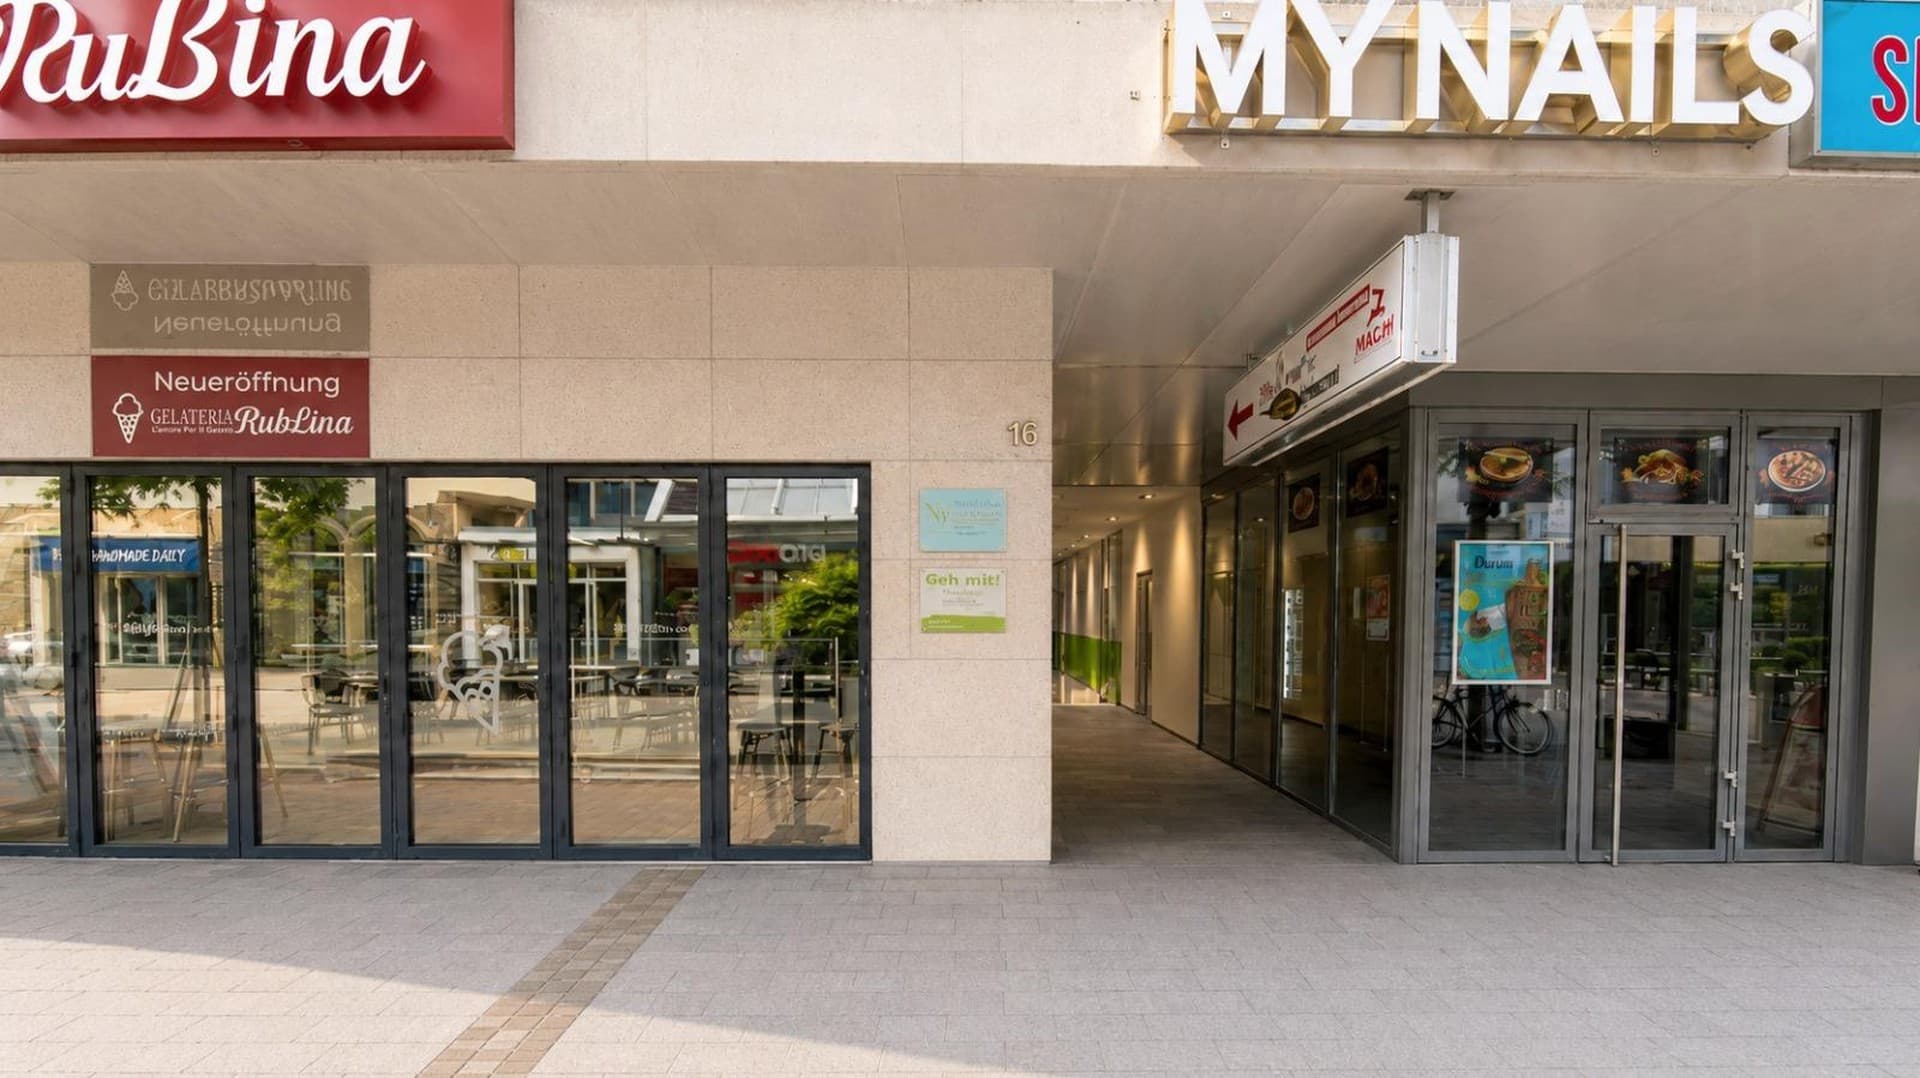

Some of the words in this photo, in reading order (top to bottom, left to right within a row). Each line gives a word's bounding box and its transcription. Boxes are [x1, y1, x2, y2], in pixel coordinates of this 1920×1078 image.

[1870, 34, 1920, 126] S
[154, 371, 340, 398] Neueröffnung
[150, 408, 233, 425] GELATERIA
[1007, 421, 1038, 446] 16
[925, 573, 959, 586] Geh
[965, 573, 1000, 587] mit!
